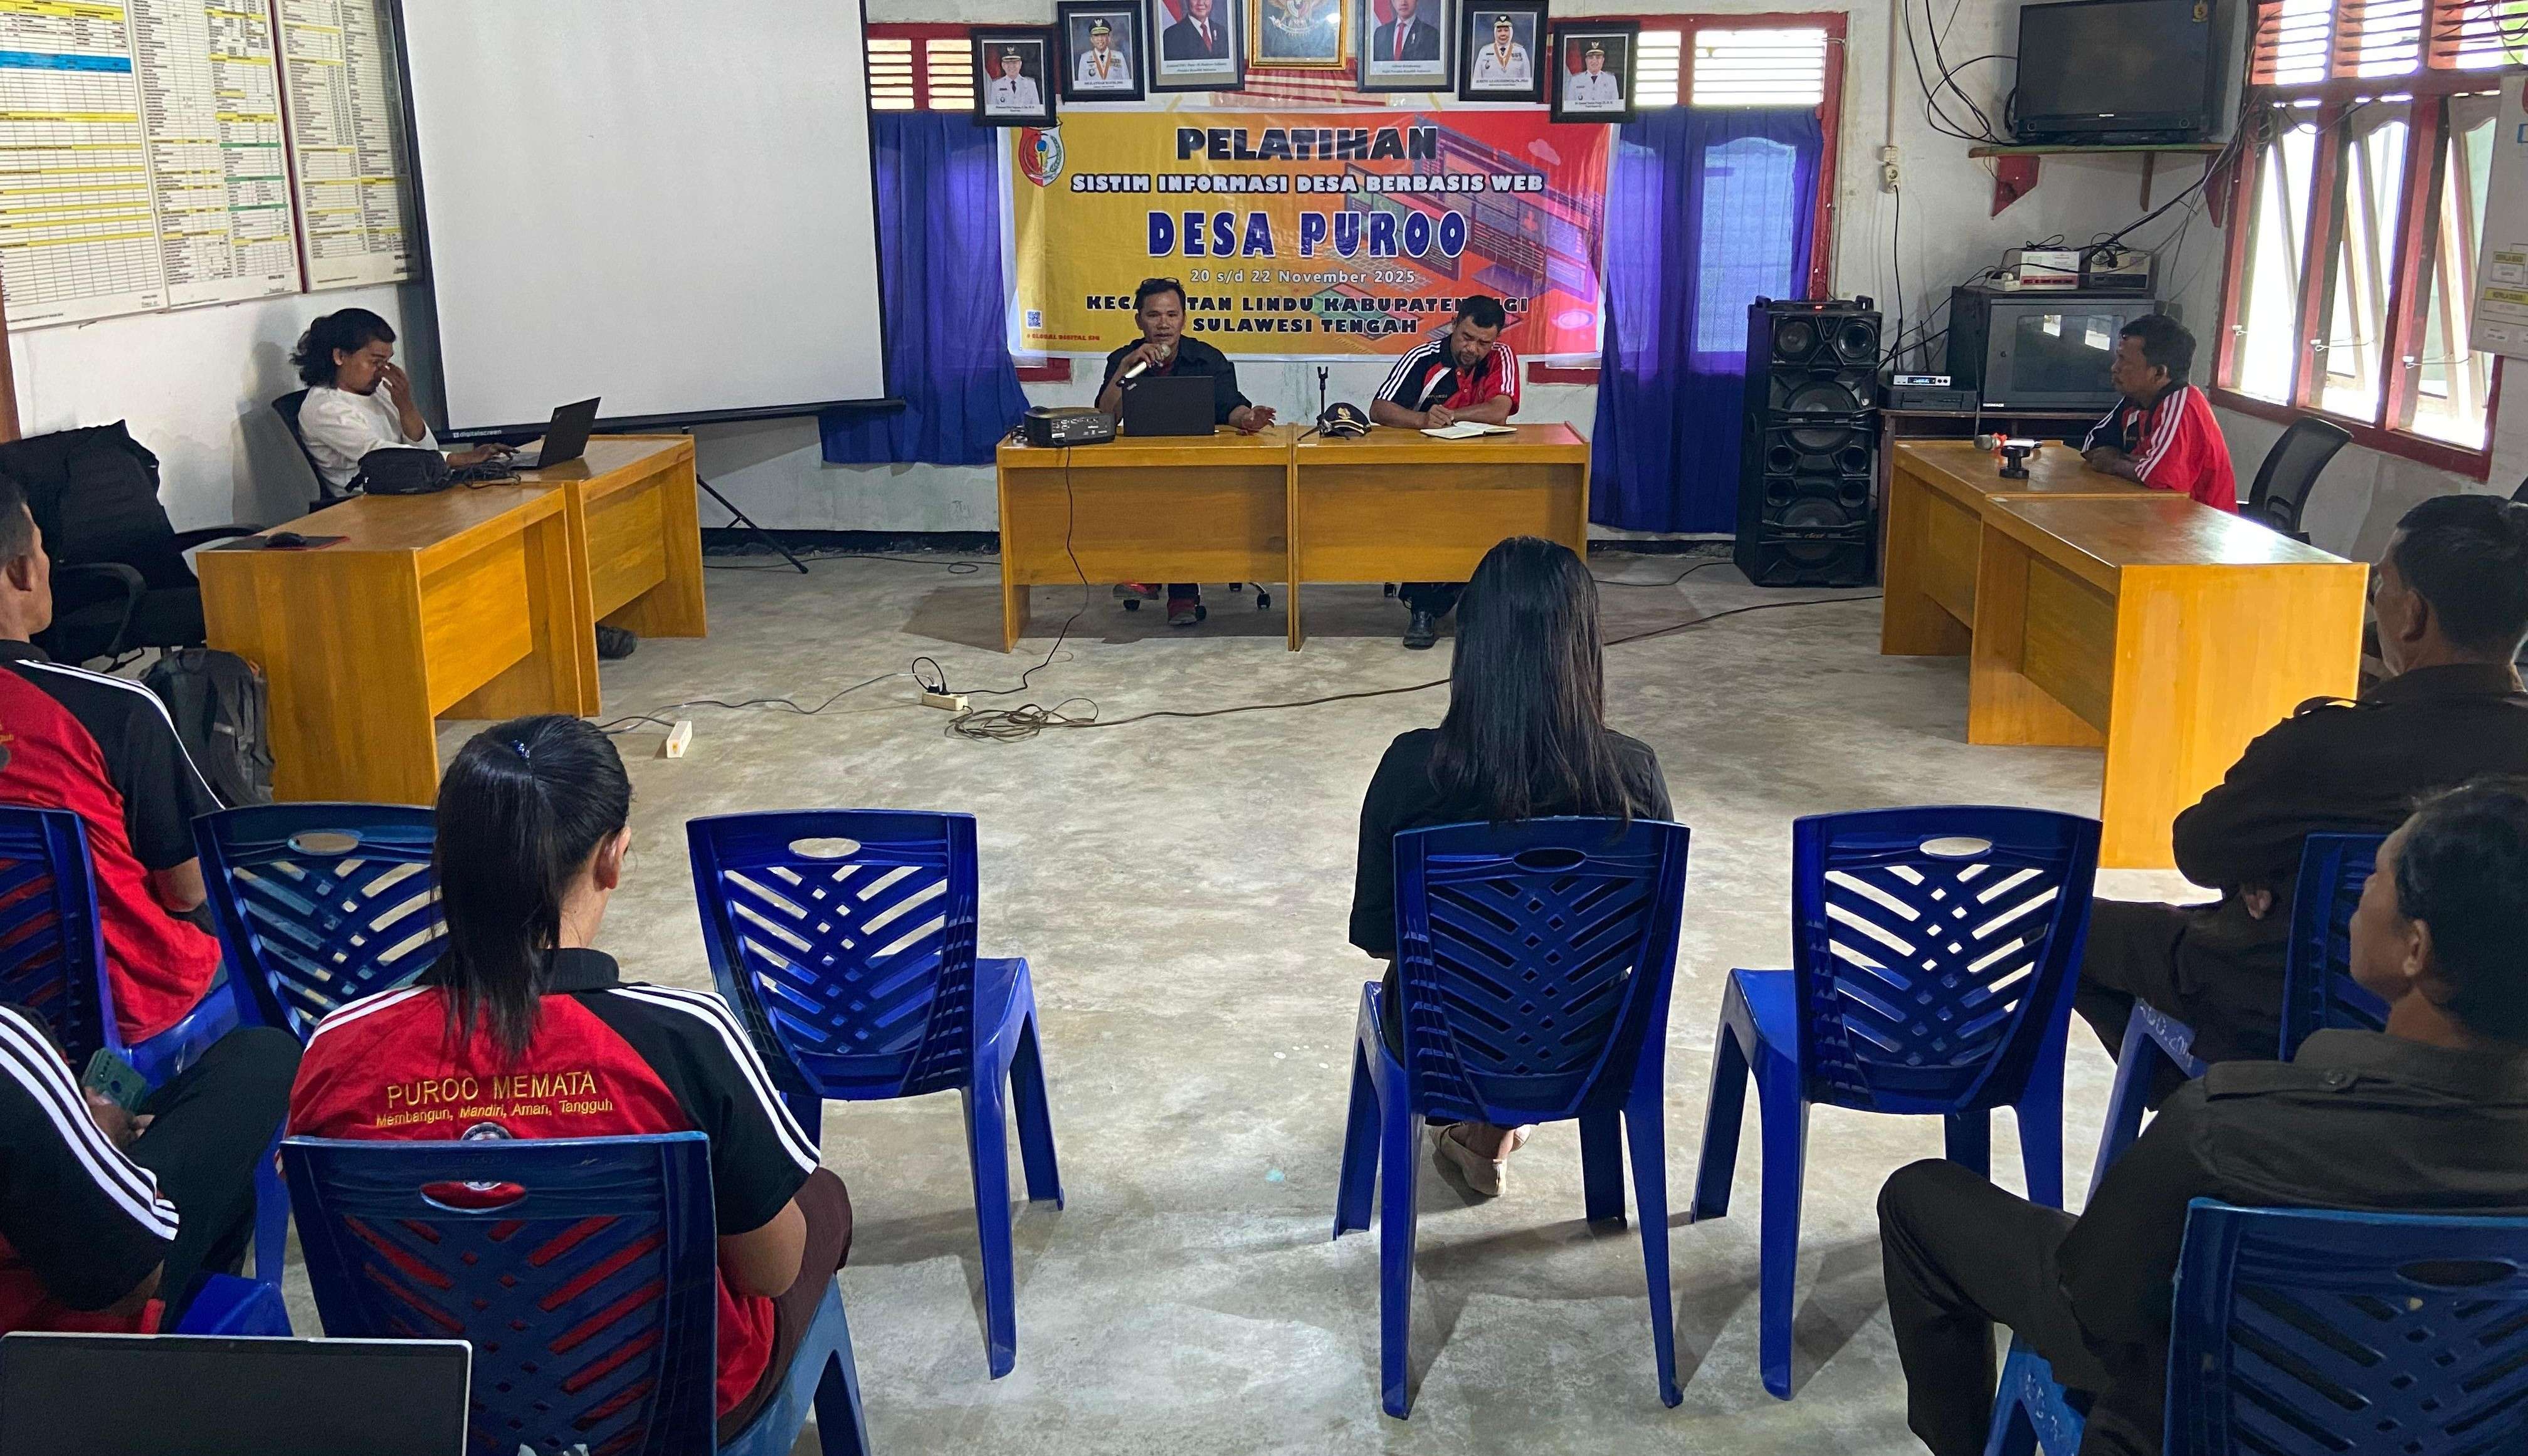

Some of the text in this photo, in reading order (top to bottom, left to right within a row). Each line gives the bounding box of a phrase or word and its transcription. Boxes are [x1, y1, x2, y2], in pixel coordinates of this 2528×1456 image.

[1176, 127, 1439, 160] PELATIHAN
[1071, 174, 1544, 193] SISTIM INFORMASI DESA BERBASIS WEB
[1147, 211, 1467, 258] DESA PUROO
[1191, 270, 1416, 283] 20 s/d 22 November 2025
[1087, 296, 1232, 312] KECTAN
[1242, 296, 1314, 312] LINDU
[1193, 318, 1418, 333] SULAWESI TENGAH
[387, 1070, 597, 1108] PUROO MEMATA
[376, 1098, 613, 1127] Membangun, Mandiri, Aman, Tangguh
